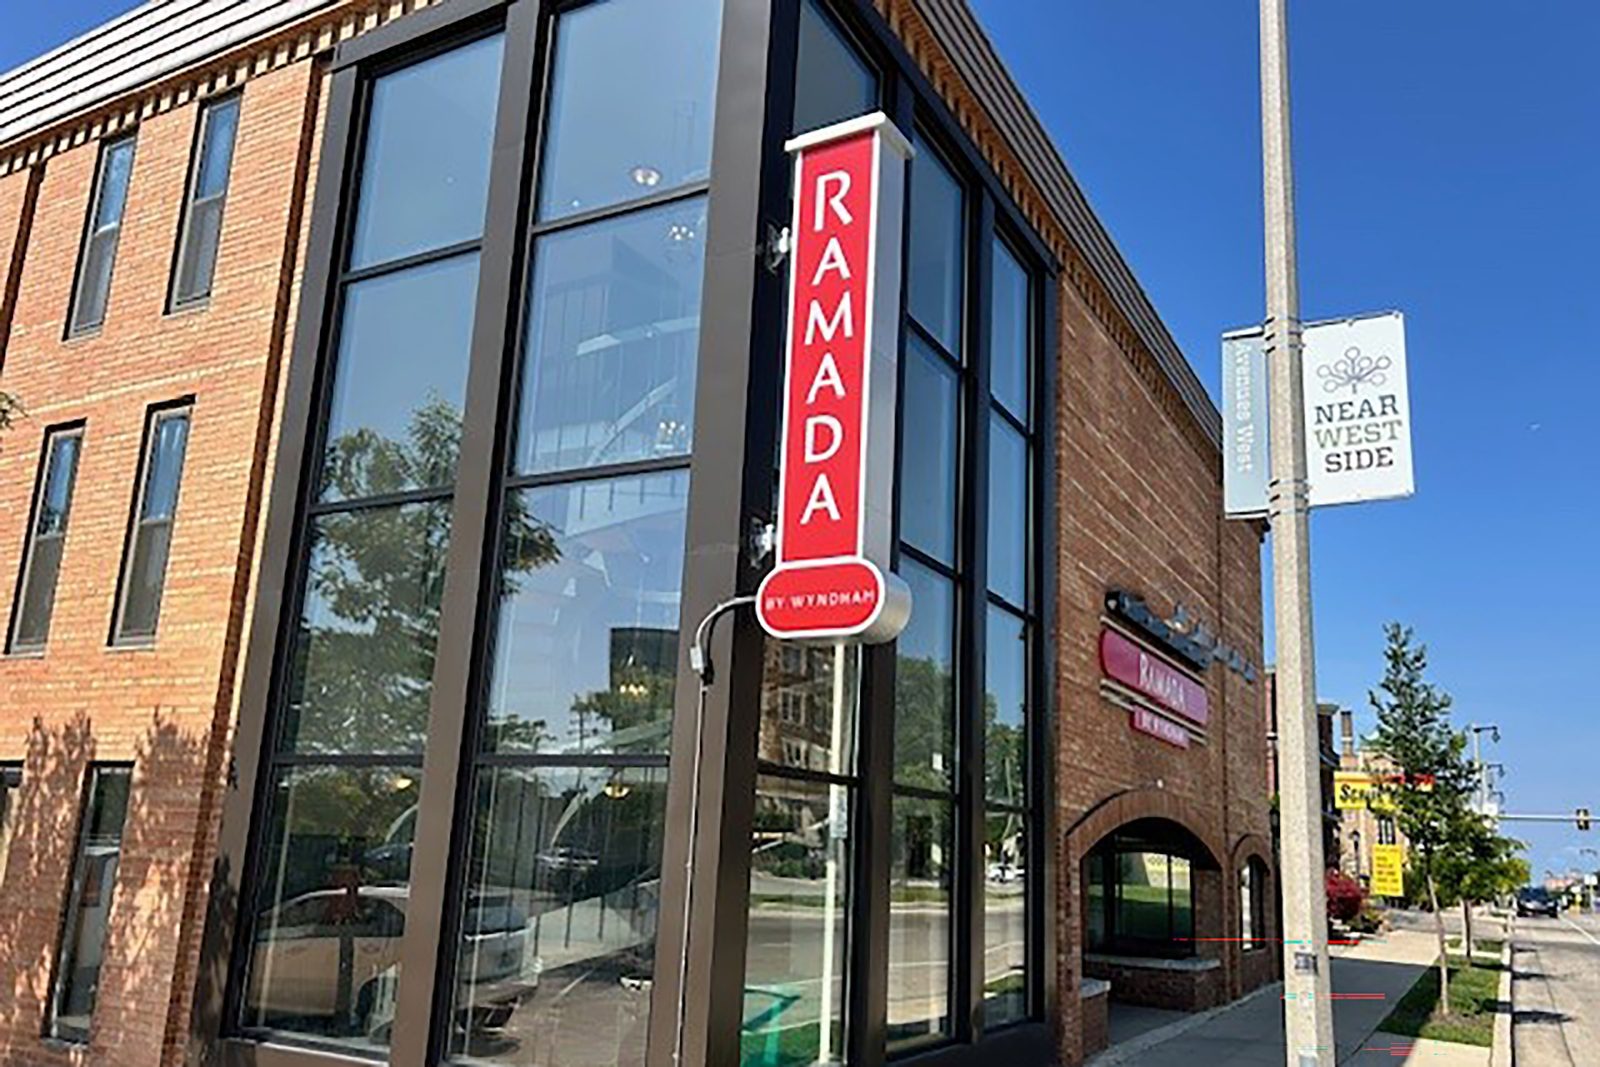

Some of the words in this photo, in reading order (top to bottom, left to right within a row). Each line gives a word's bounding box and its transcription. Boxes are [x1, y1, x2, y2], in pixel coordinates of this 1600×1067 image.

[800, 169, 853, 525] RAMADA
[1314, 393, 1400, 425] NEAR
[1236, 423, 1254, 473] West
[1314, 419, 1403, 449] WEST
[1324, 446, 1394, 473] SIDE
[765, 596, 784, 610] BY
[790, 589, 874, 609] WYNDHAM
